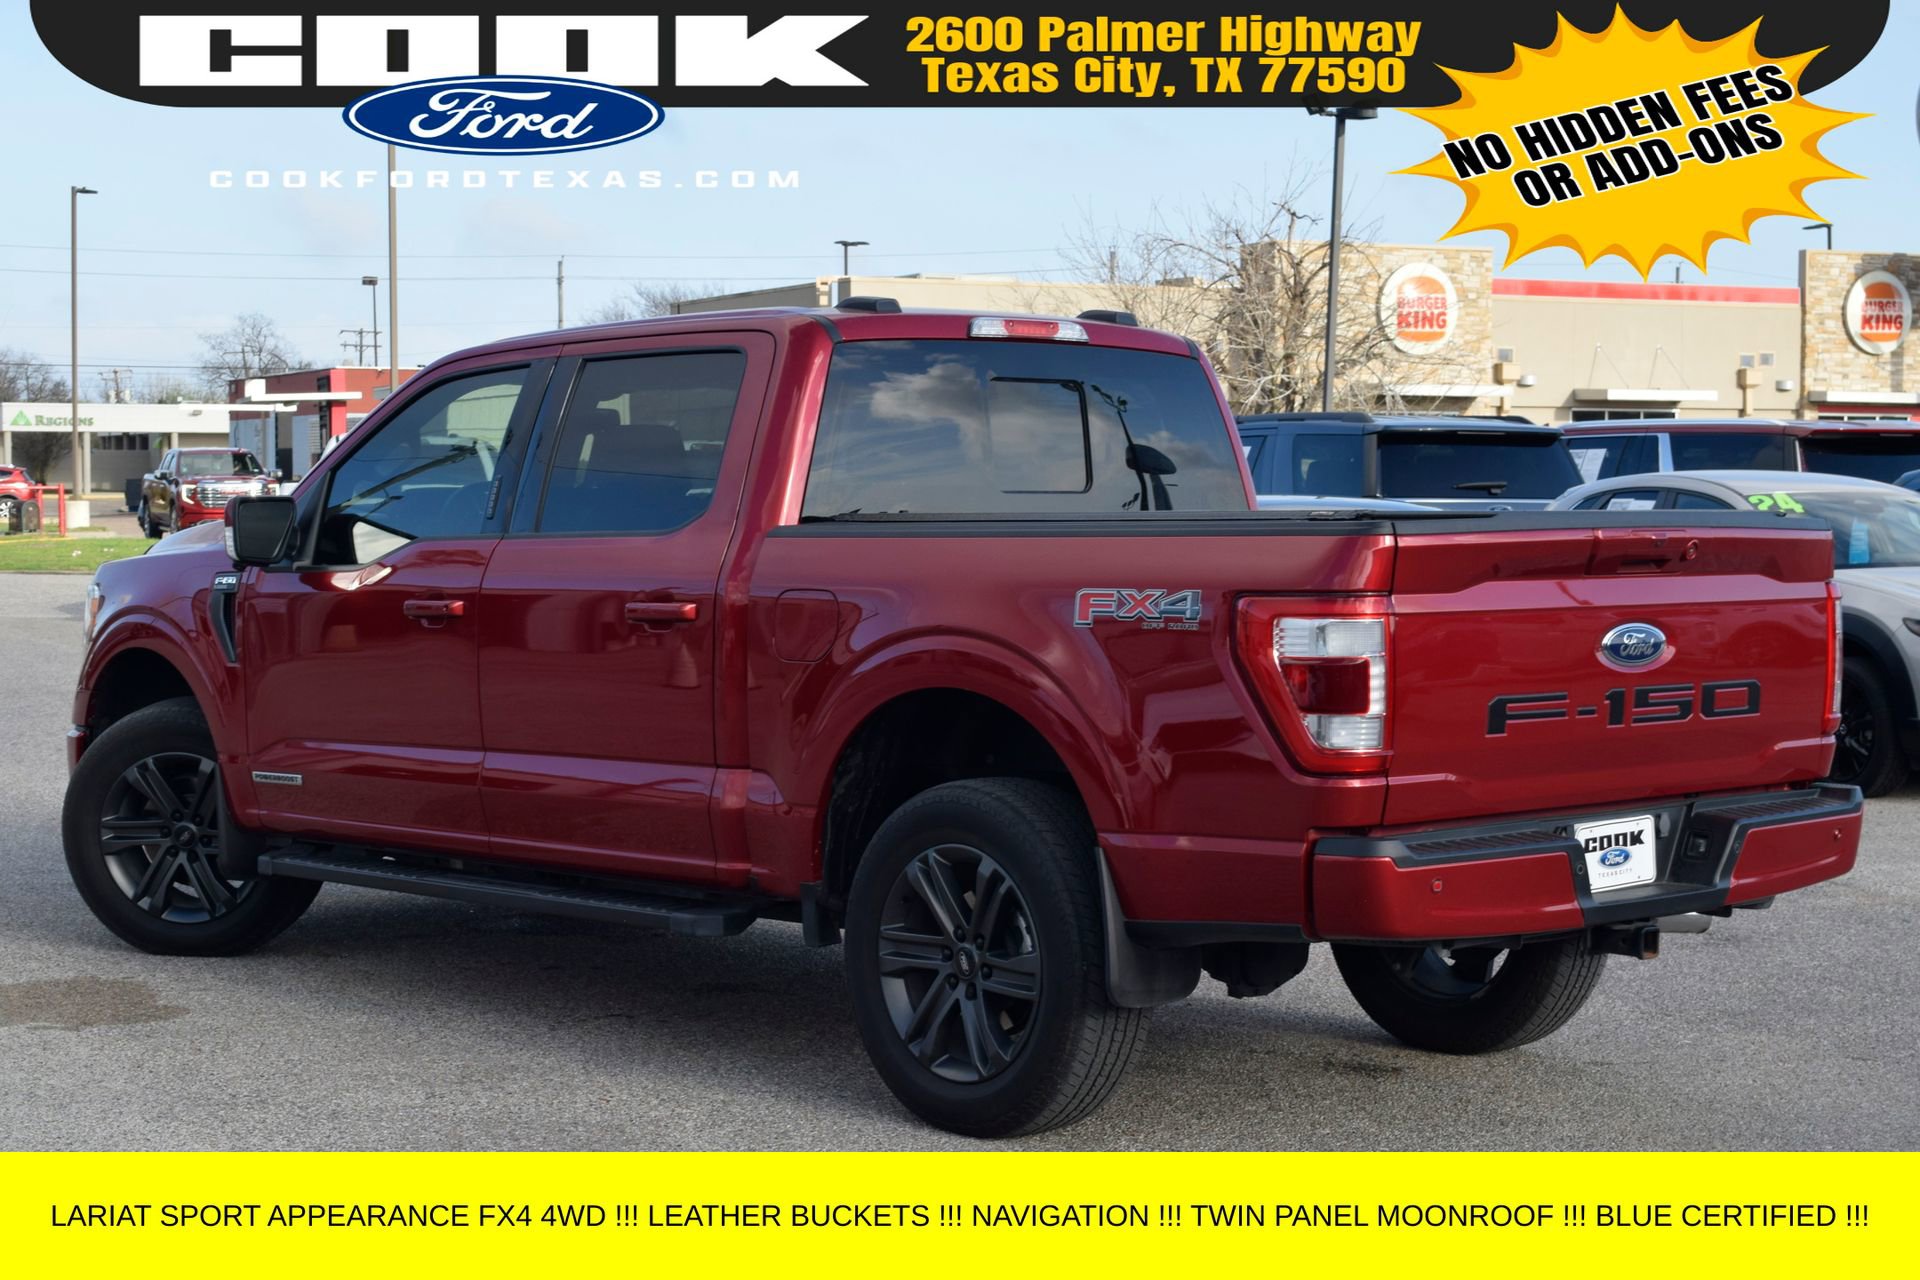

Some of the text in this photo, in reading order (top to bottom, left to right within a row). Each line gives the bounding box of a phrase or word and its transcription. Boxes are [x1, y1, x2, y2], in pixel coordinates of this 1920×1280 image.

[1396, 295, 1448, 311] BURGER
[1861, 300, 1904, 313] BURGER
[1396, 311, 1448, 330] KING
[1860, 313, 1904, 331] KING
[1073, 588, 1202, 628] FX4
[1620, 632, 1655, 657] Ford
[1485, 679, 1761, 738] F-150
[1583, 828, 1645, 854] COOK
